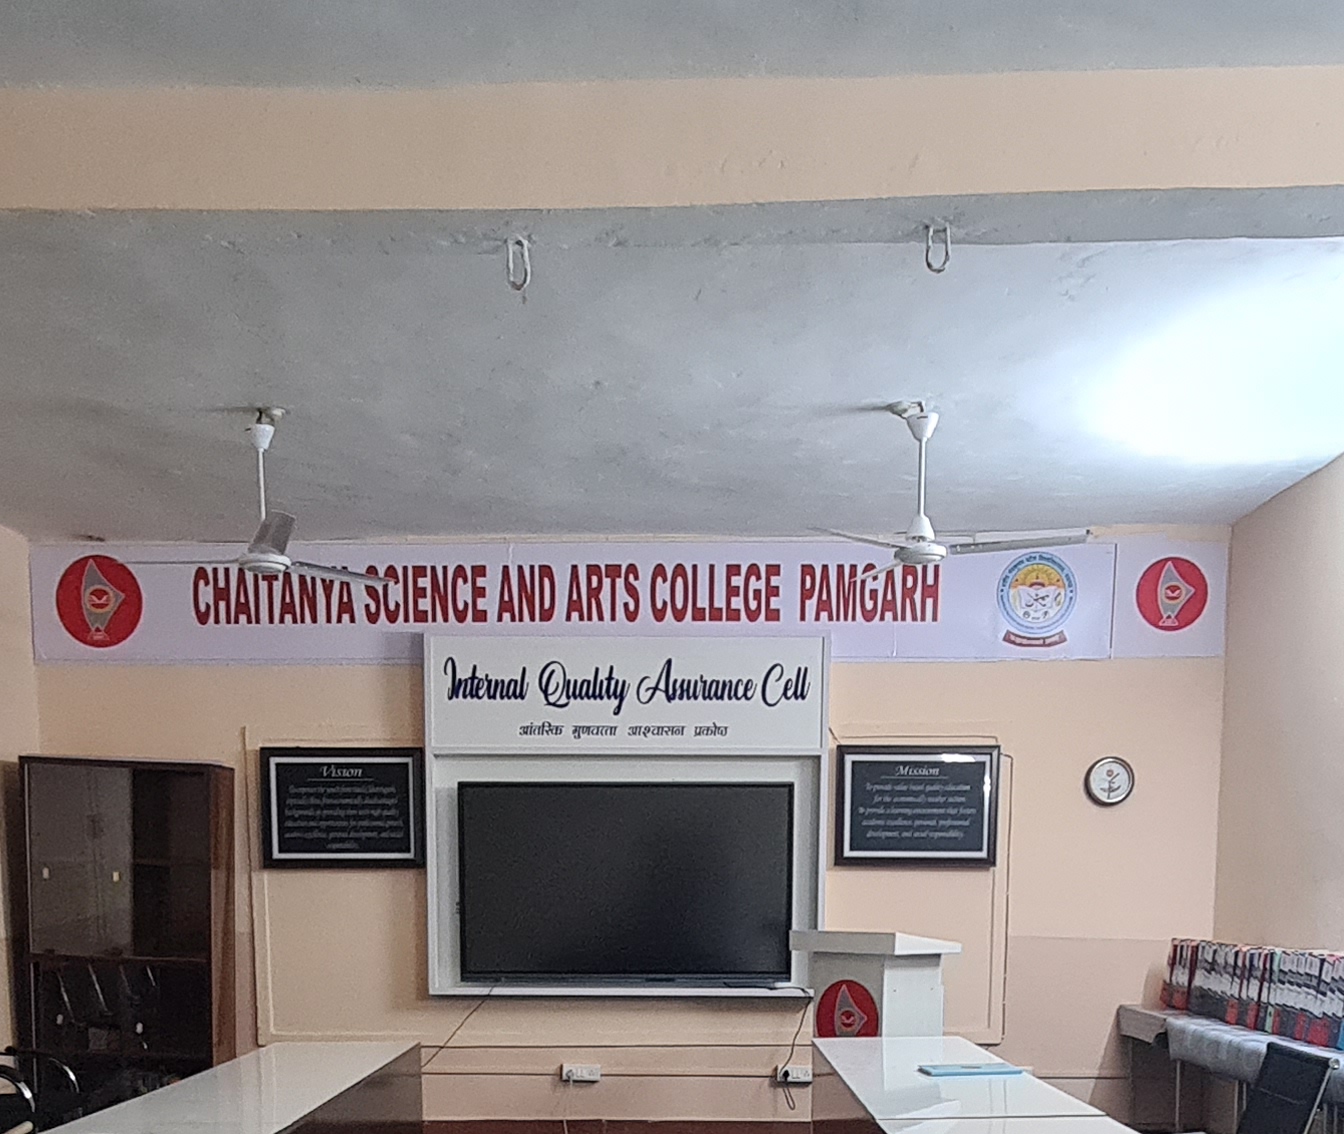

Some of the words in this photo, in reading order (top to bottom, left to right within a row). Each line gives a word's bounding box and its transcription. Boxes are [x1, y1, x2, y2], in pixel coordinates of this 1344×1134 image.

[192, 566, 356, 625] CHAITANYA
[364, 565, 488, 624] SCIENCE
[497, 565, 556, 623] AND
[566, 564, 641, 622] ARTS
[650, 563, 780, 623] COLLEGE
[799, 563, 940, 622] PAMGARH
[444, 656, 529, 701] Internal
[538, 660, 630, 716] Quality
[637, 657, 758, 705] Assurance
[761, 662, 811, 707] Cell
[320, 765, 362, 778] Vision
[895, 765, 940, 776] Mission
